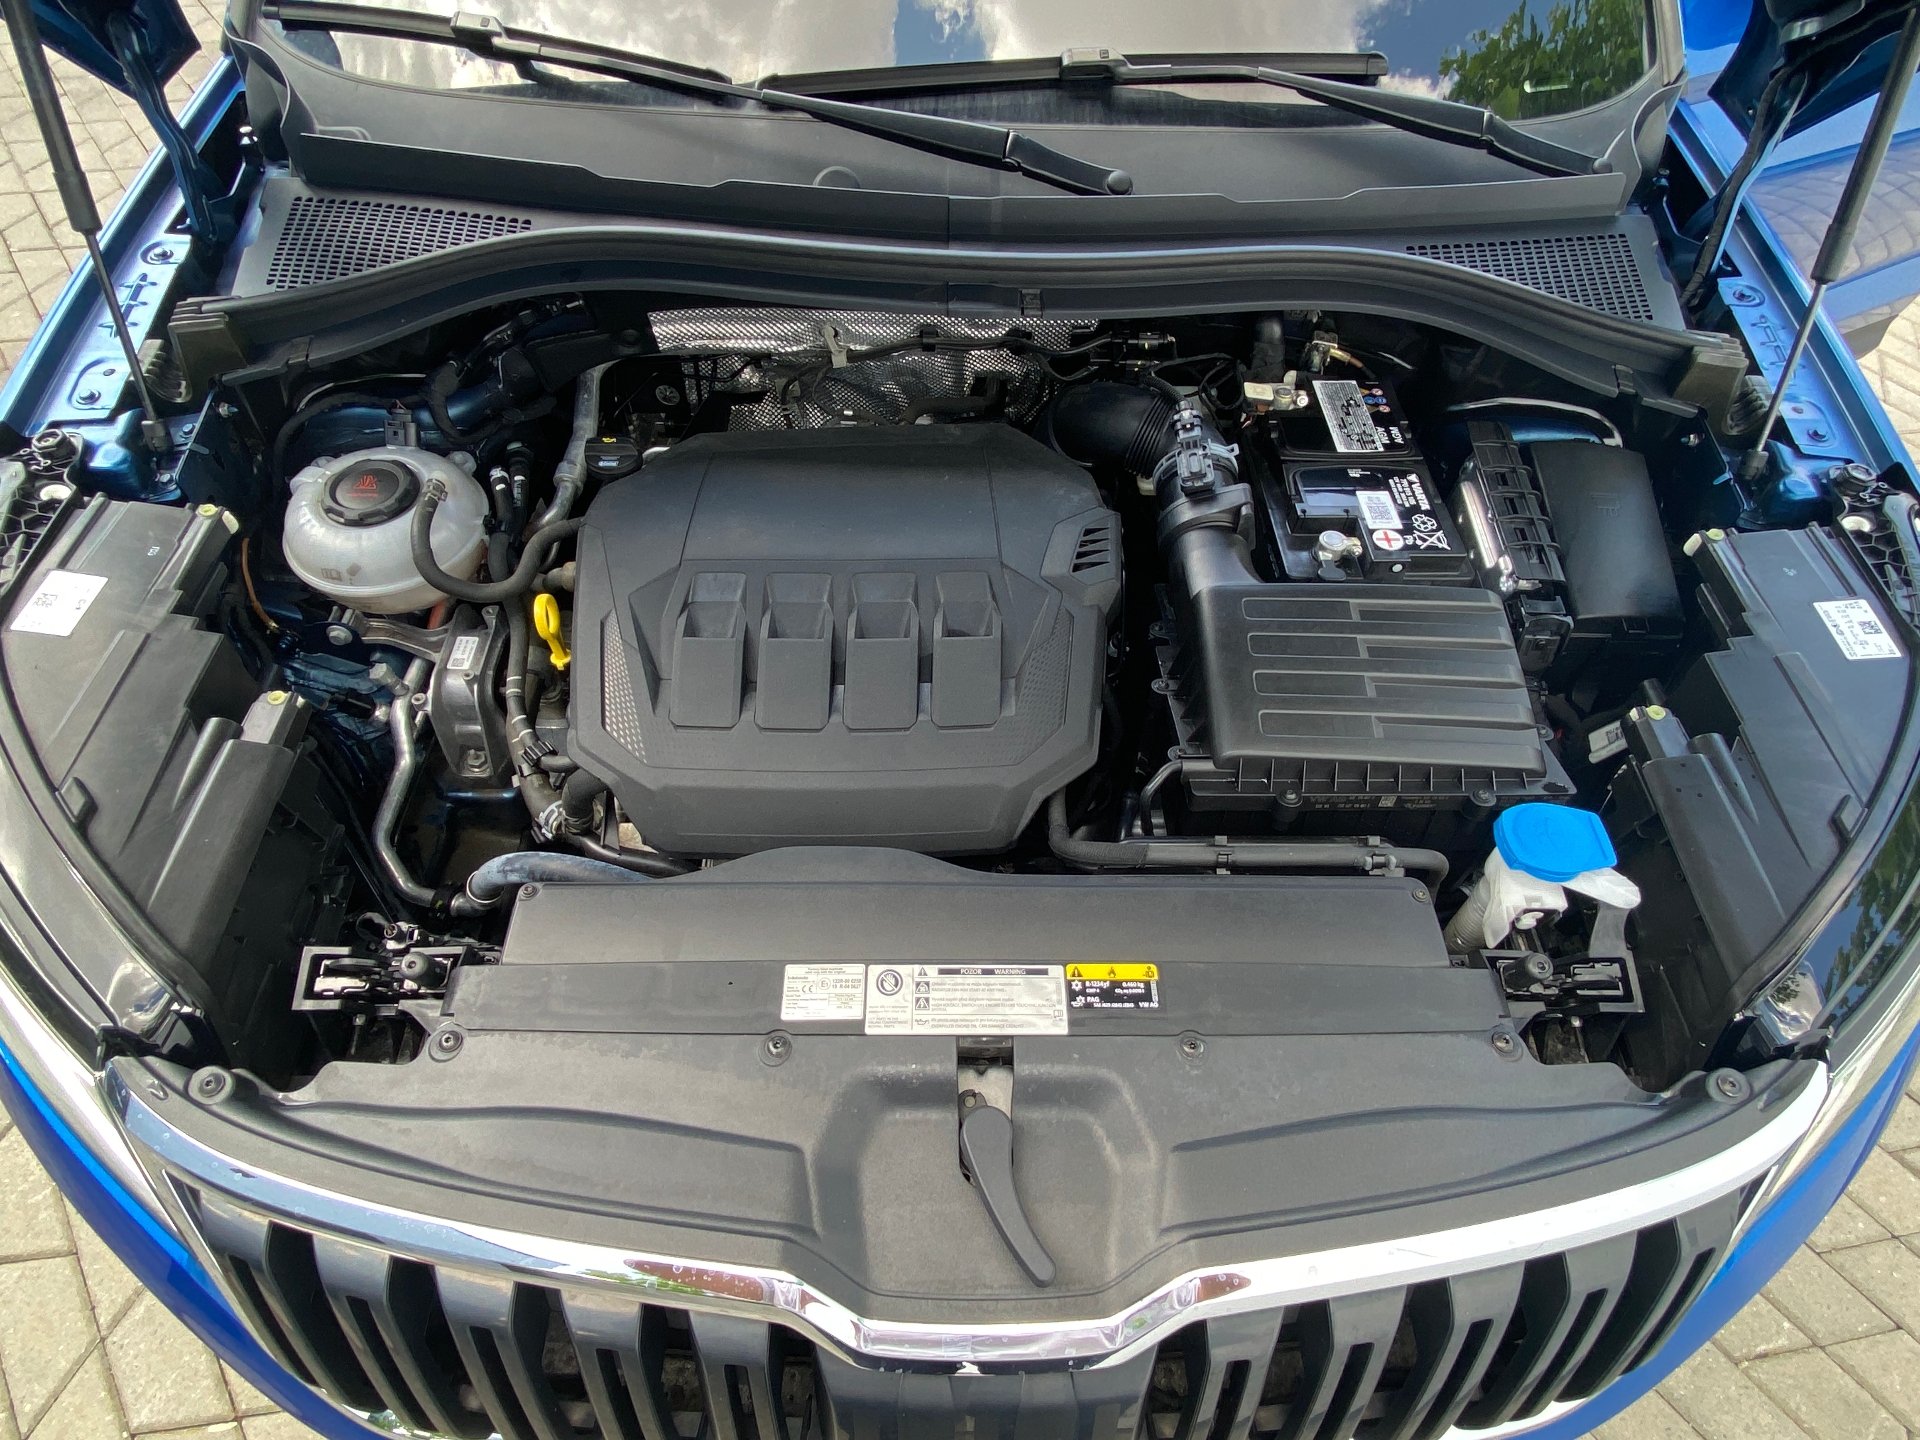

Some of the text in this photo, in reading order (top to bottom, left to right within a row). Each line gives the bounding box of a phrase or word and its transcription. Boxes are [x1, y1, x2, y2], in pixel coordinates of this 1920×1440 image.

[1375, 426, 1390, 444] AGM
[1389, 426, 1404, 444] AGM
[1411, 483, 1430, 511] VARTA
[1403, 535, 1414, 545] Pb
